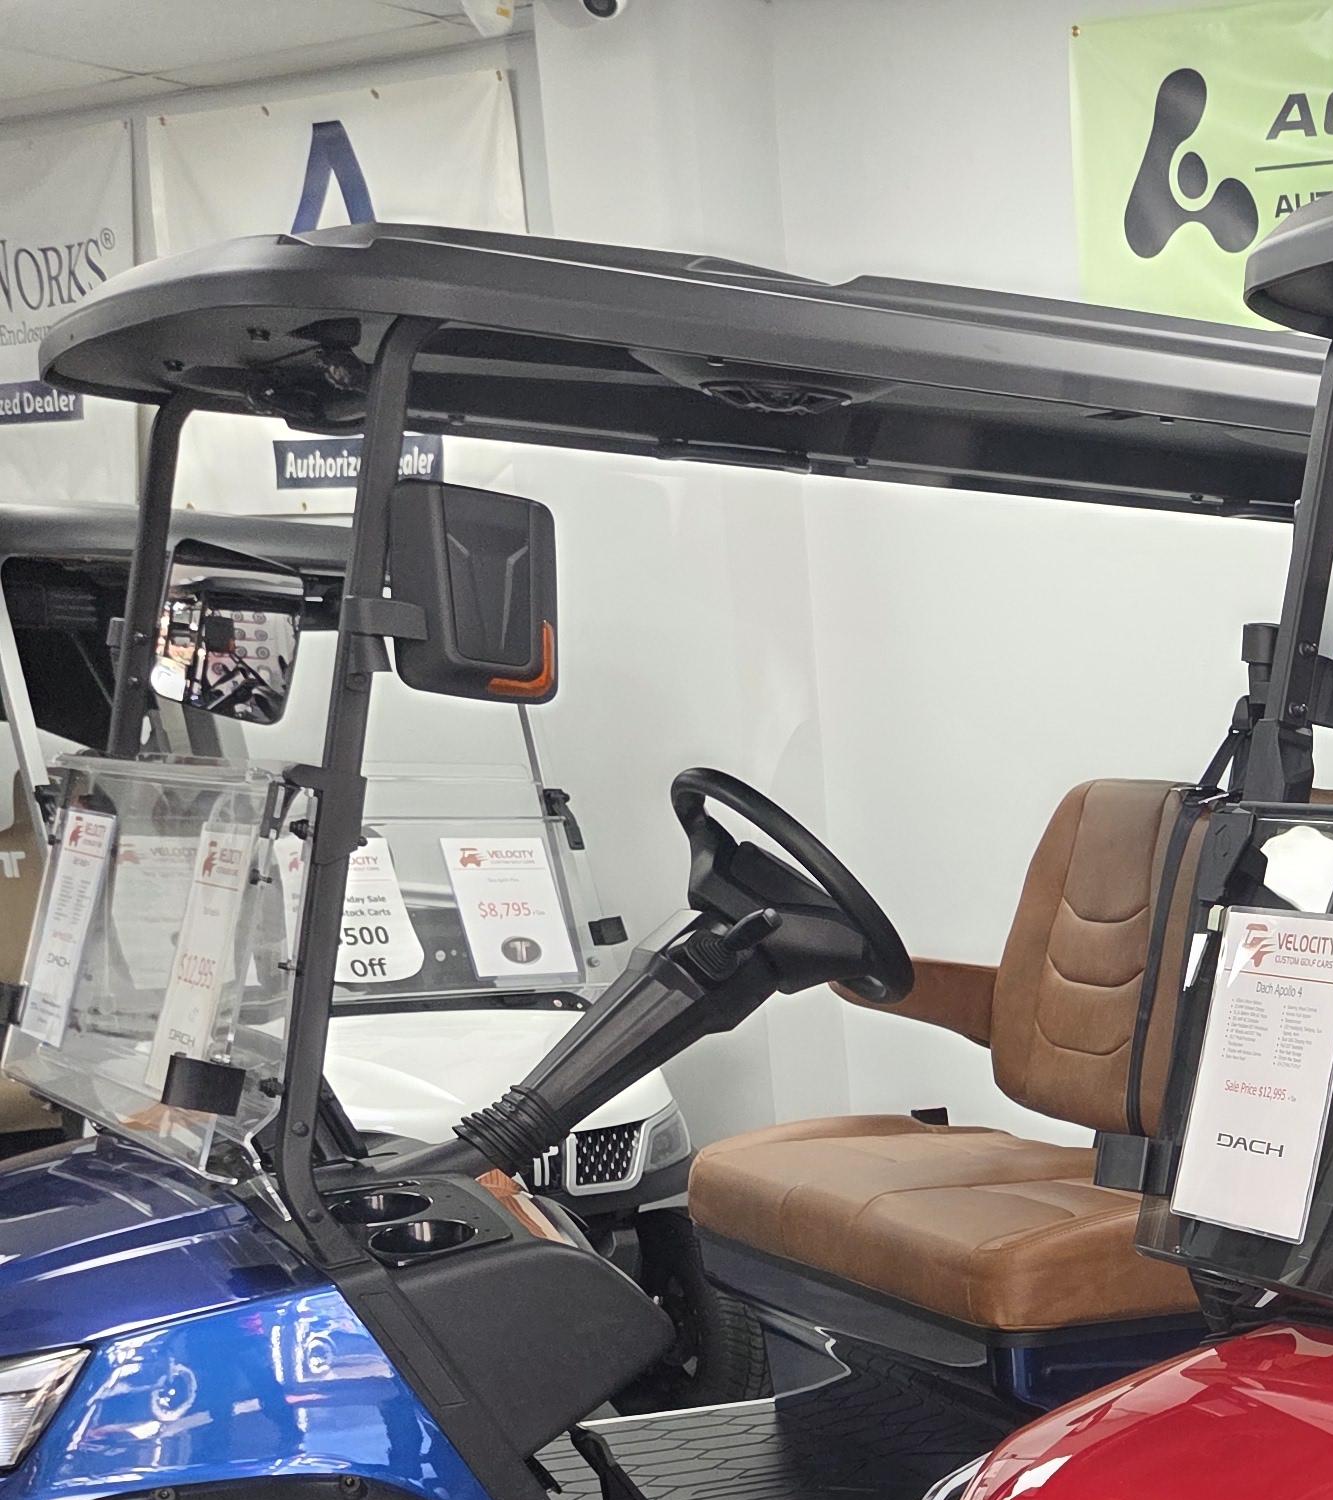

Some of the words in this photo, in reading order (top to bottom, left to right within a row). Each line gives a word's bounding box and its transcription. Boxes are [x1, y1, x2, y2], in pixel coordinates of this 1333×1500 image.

[24, 389, 76, 414] Dealer
[486, 849, 534, 859] VELOCITY
[366, 895, 387, 904] Sale
[368, 908, 392, 918] Carts
[478, 901, 532, 919] $8,795
[350, 957, 388, 978] Off
[1274, 955, 1300, 966] CUSTOM
[1300, 958, 1317, 968] GOLF
[1317, 960, 1333, 970] CARS
[1256, 981, 1274, 995] Dach
[1274, 983, 1297, 998] Apollo
[1224, 1079, 1240, 1093] Sale
[1240, 1082, 1258, 1096] Price
[1258, 1086, 1287, 1101] $12,995
[1216, 1132, 1285, 1158] DACH
